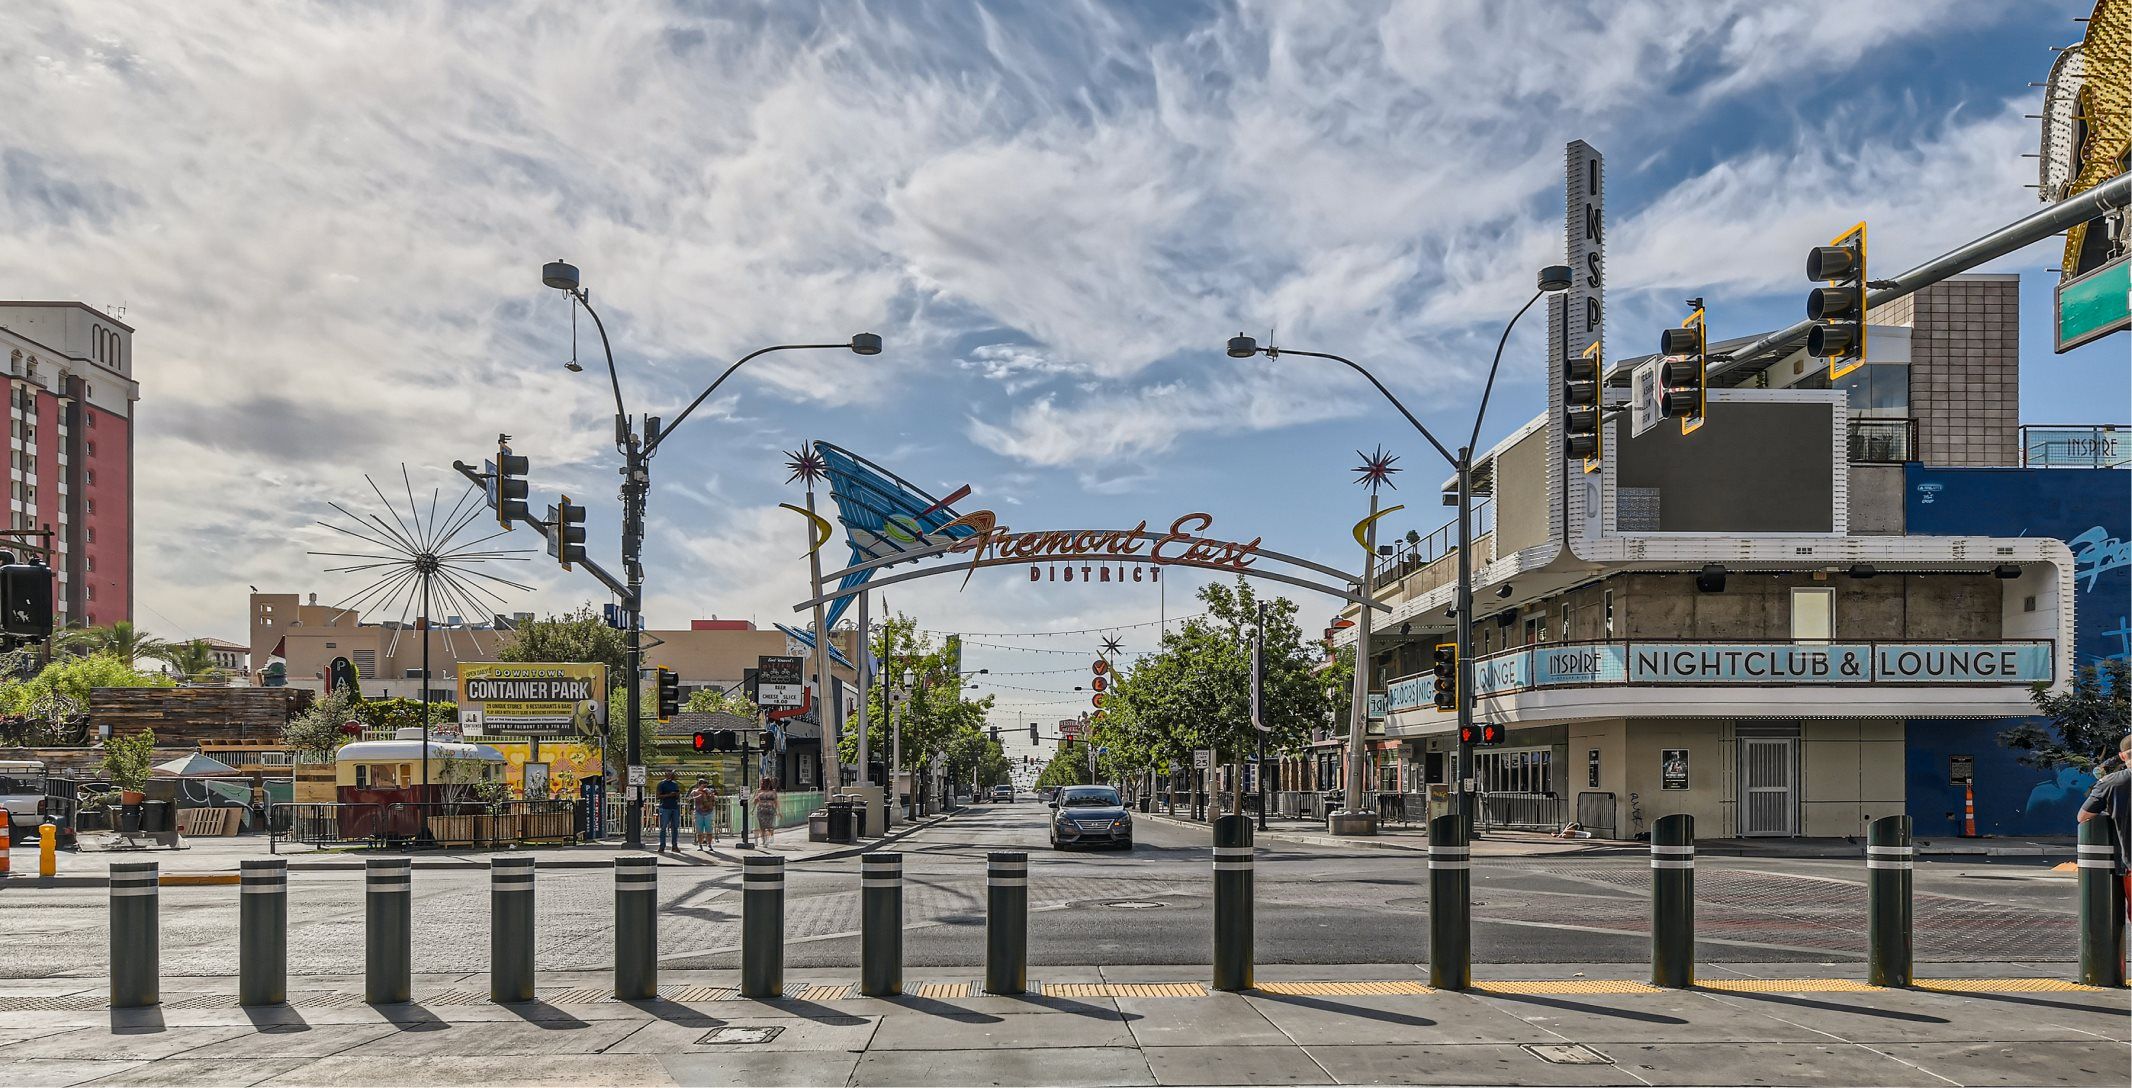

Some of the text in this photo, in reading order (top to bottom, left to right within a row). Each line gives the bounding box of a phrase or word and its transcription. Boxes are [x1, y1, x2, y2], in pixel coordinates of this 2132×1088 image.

[2067, 435, 2118, 457] INSPIRE
[928, 509, 1263, 593] Fremont East
[1030, 566, 1161, 582] DISTRICT
[1549, 650, 1602, 675] INSPIRE
[1639, 651, 2018, 676] NIGHTCLUB & LOUNGE
[495, 669, 565, 678] DOWNTOWN
[469, 681, 589, 699] CONTAINER PARK
[1195, 759, 1208, 767] 25
